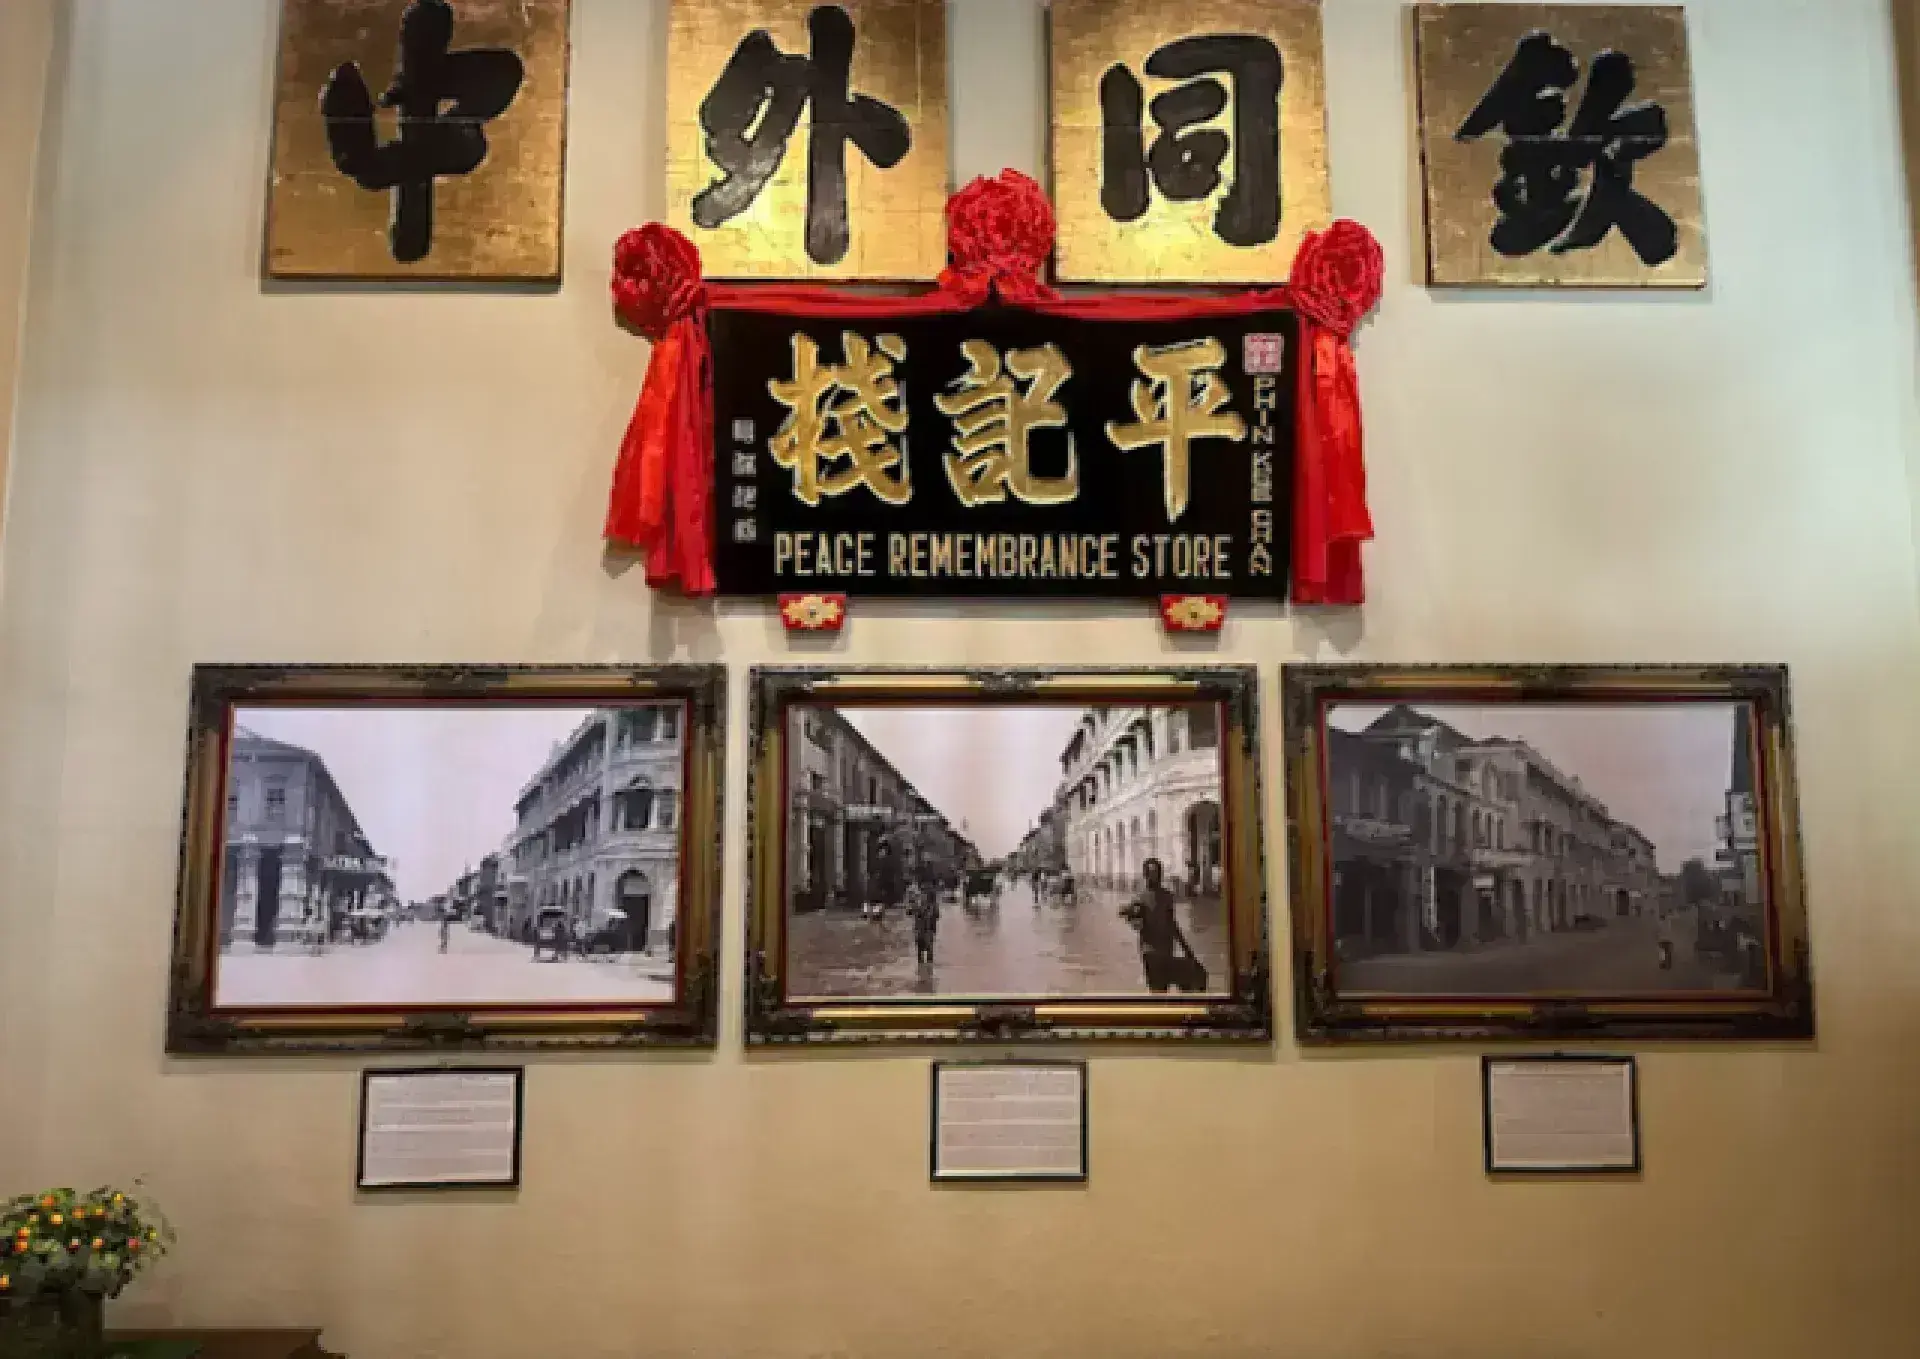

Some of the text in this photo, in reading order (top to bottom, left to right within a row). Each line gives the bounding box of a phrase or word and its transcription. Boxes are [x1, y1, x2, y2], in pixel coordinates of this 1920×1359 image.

[320, 0, 525, 263] 中
[692, 5, 911, 265] 外
[1099, 33, 1283, 247] 同
[887, 531, 1120, 579] REMEMBRANCE
[1131, 532, 1233, 579] STORE
